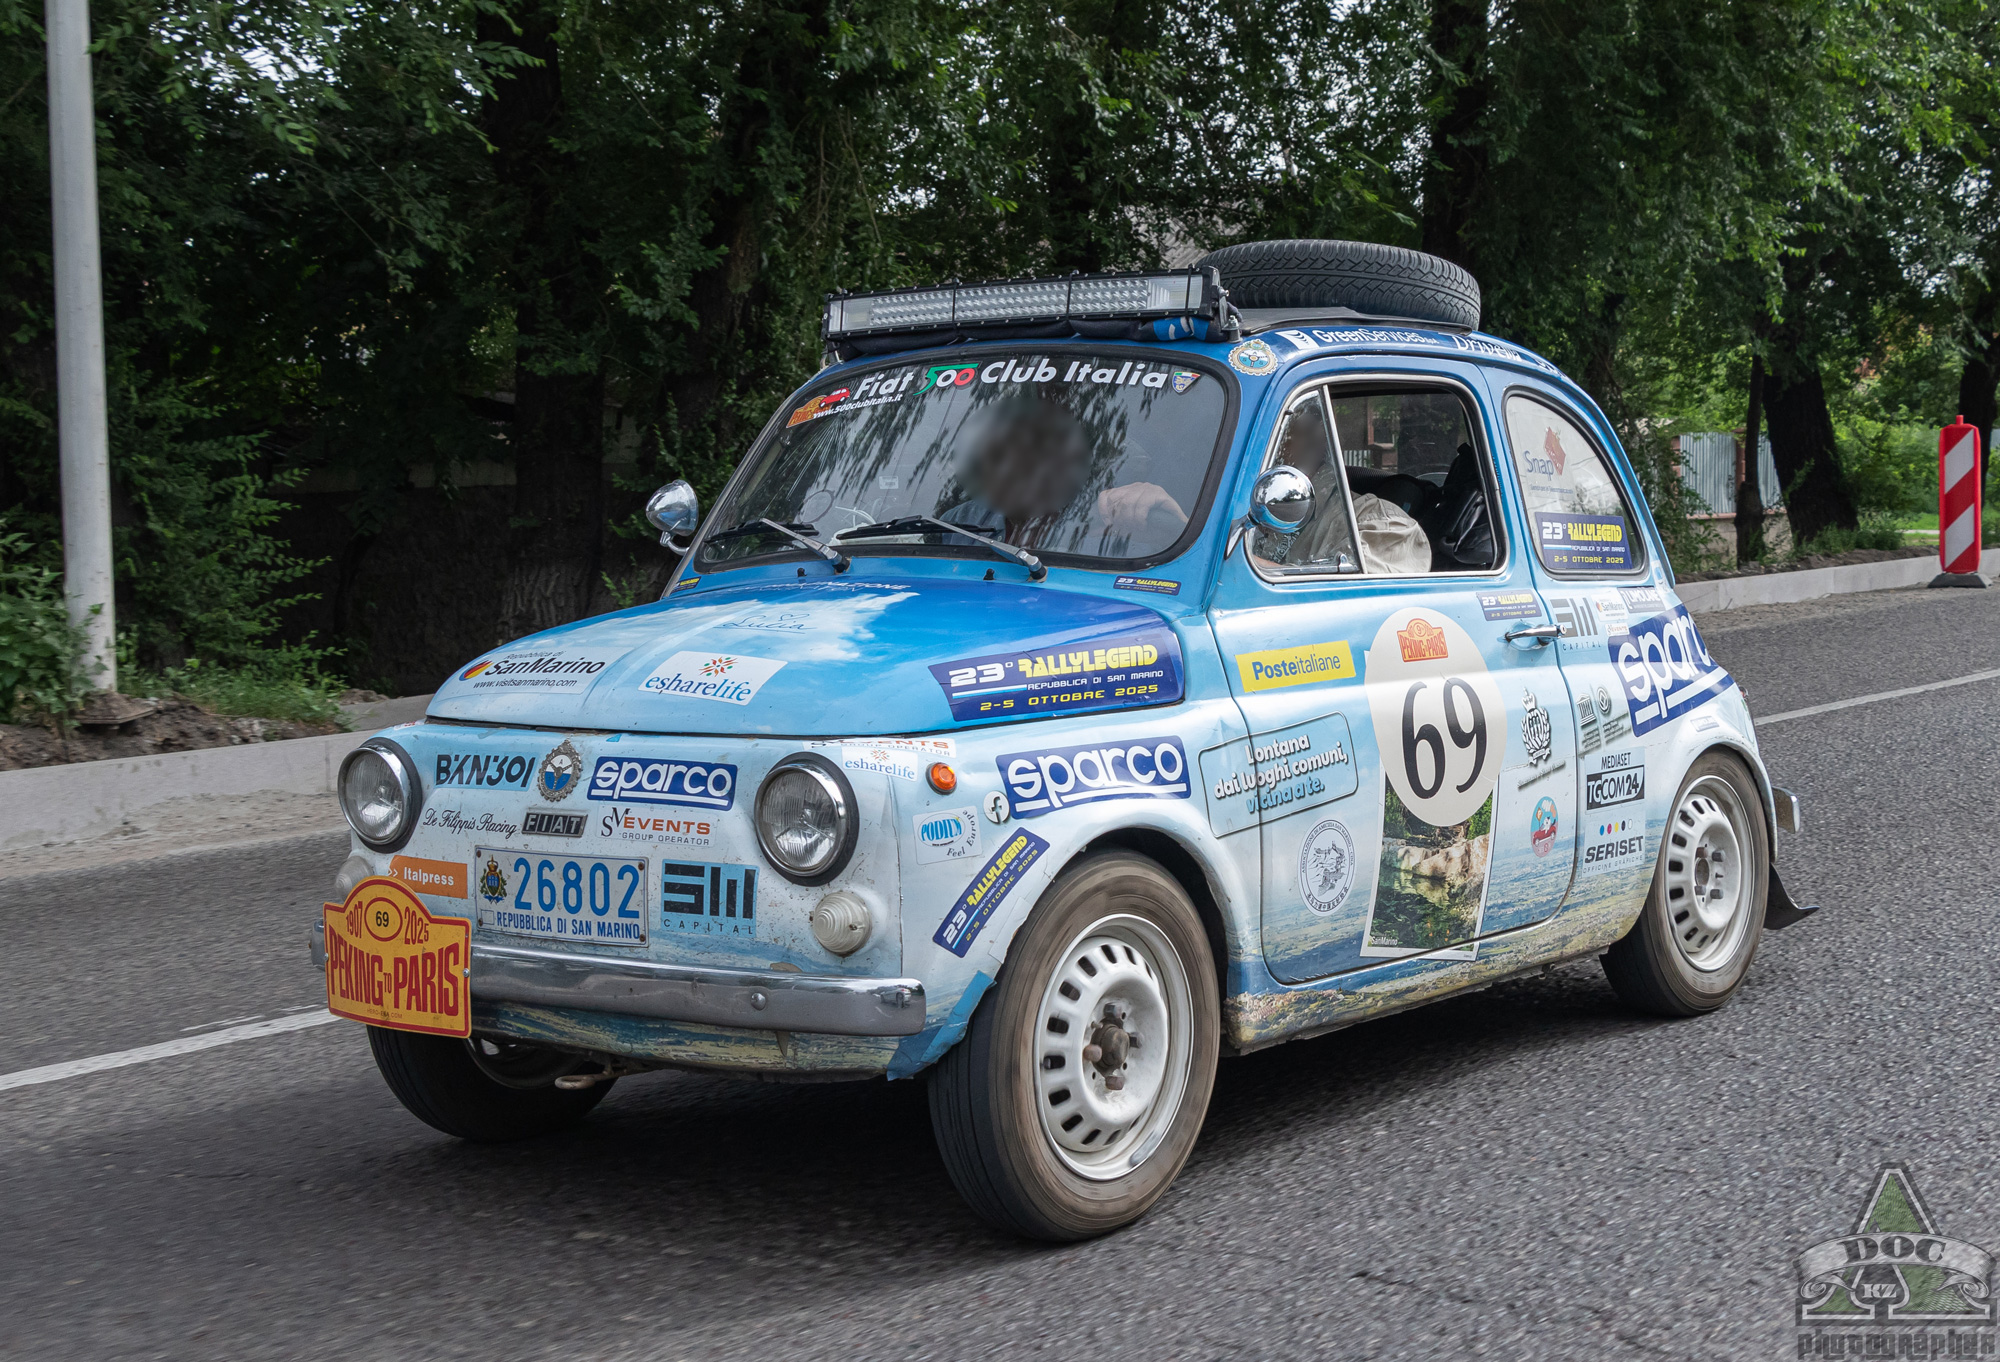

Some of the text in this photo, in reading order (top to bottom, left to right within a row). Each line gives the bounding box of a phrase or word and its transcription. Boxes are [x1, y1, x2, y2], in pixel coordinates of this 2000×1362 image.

[1312, 328, 1426, 343] GreenServices
[854, 358, 1168, 400] Fiat 500 Club Italia
[813, 393, 903, 419] www.500clubitalia.it
[1523, 450, 1555, 481] Snap
[1567, 522, 1623, 542] RALLYLEGEND
[1562, 641, 1602, 651] CAPITAL
[485, 657, 605, 676] SanMarino
[949, 644, 1158, 688] 23° RALLYLEGEND
[1252, 653, 1341, 681] Posteitaliane
[473, 678, 578, 689] www.visitsanmarino.com
[645, 673, 751, 701] esharelife
[1027, 678, 1087, 691] REPUBBLICA
[1107, 674, 1126, 683] SAN
[1131, 670, 1163, 680] MARINO
[980, 685, 1158, 711] 2-5 OTTOBRE 2025
[888, 744, 951, 757] OPERATOR
[1244, 734, 1311, 764] Lontana
[1402, 677, 1487, 799] 69
[845, 758, 915, 779] esharelife
[1213, 741, 1348, 799] dai luoghi comuni,
[1601, 752, 1631, 770] MEDIASET
[595, 761, 732, 799] sparco
[1007, 742, 1183, 809] sparco
[1587, 772, 1639, 803] TGCOM24
[1246, 776, 1325, 814] vicina a te.
[423, 808, 517, 839] De Filippis Racing
[525, 814, 581, 834] FIAT
[623, 816, 711, 835] EVENTS
[921, 818, 962, 841] PODIUM
[622, 832, 709, 846] GROUP OPERATOR
[946, 846, 966, 858] Feel
[1584, 835, 1643, 864] SERISET
[404, 866, 454, 886] Italpress
[966, 835, 1028, 906] RALLYLEGEND
[1583, 862, 1612, 874] OFFICINE
[514, 857, 640, 918] 26802
[965, 849, 1038, 941] 2-5 OTTOBRE 2025
[346, 901, 363, 938] 1907
[375, 911, 389, 927] 69
[404, 906, 429, 945] 2025
[497, 911, 640, 940] REPUBBLICA DI SAN MARINO
[664, 918, 754, 935] CAPITAL
[329, 924, 460, 1017] PEKING TO PARIS
